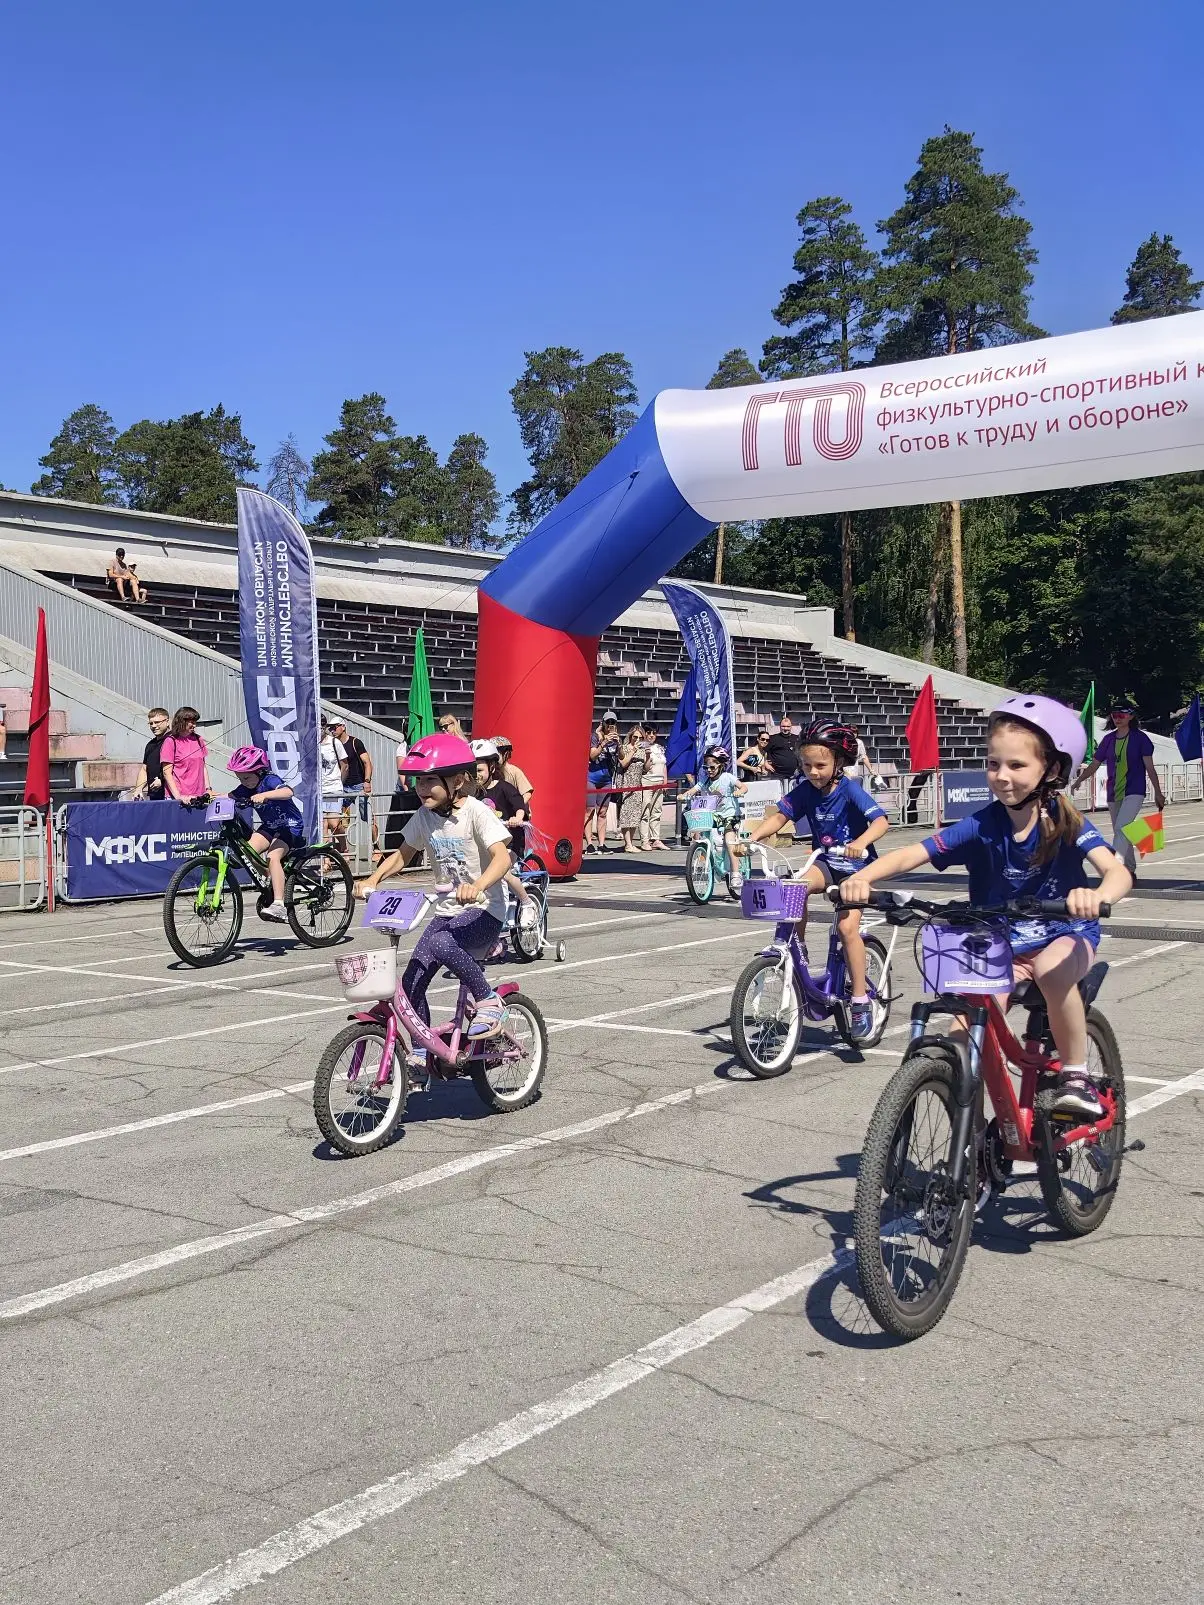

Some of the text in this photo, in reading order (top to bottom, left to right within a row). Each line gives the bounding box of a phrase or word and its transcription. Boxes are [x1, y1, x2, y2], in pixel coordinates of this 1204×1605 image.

[877, 360, 1188, 431] физкультурно-спортивный
[880, 358, 1047, 398] Всероссийский
[742, 382, 866, 471] ГТО
[878, 400, 1189, 455] «Готов к труду и обороне»
[215, 802, 221, 814] 5
[85, 833, 167, 865] МФКС
[379, 896, 403, 915] 29
[752, 889, 767, 909] 45
